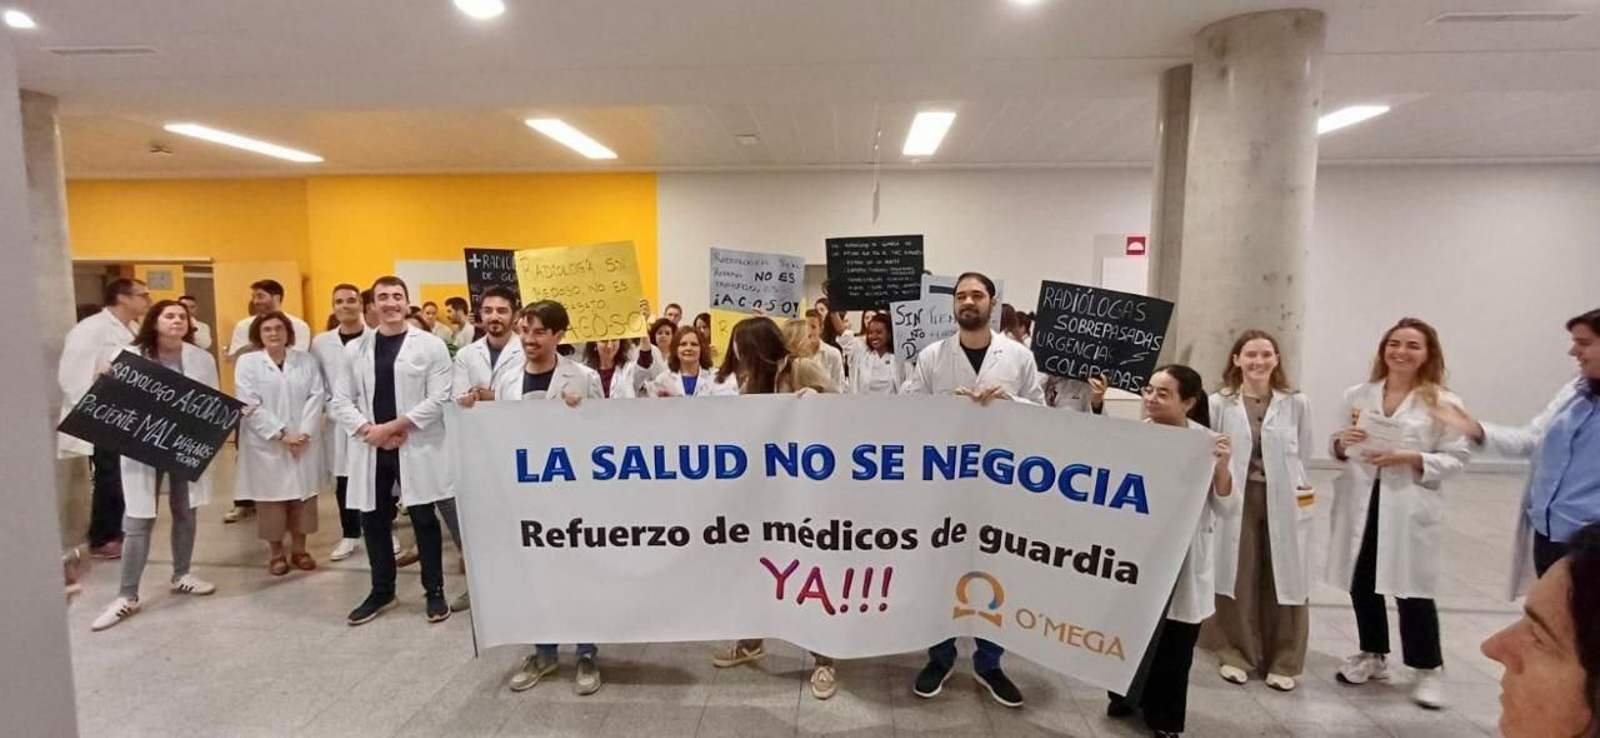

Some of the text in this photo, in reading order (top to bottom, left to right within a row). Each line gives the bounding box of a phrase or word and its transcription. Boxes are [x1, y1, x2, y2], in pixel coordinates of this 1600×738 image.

[589, 283, 605, 293] NO
[613, 280, 628, 293] ES
[754, 270, 773, 283] NO
[778, 271, 796, 285] ES
[895, 304, 924, 328] SIN
[1043, 287, 1147, 322] RADIÓLOGAS
[1053, 314, 1163, 352] SOBREPASADAS
[78, 393, 138, 432] PACIENTE
[133, 413, 177, 451] MAL
[514, 443, 1150, 514] LA SALUD NO SE NEGOCIA
[520, 516, 1140, 585] Refuerzo de médicos de guardia
[759, 557, 893, 616] YA!!!
